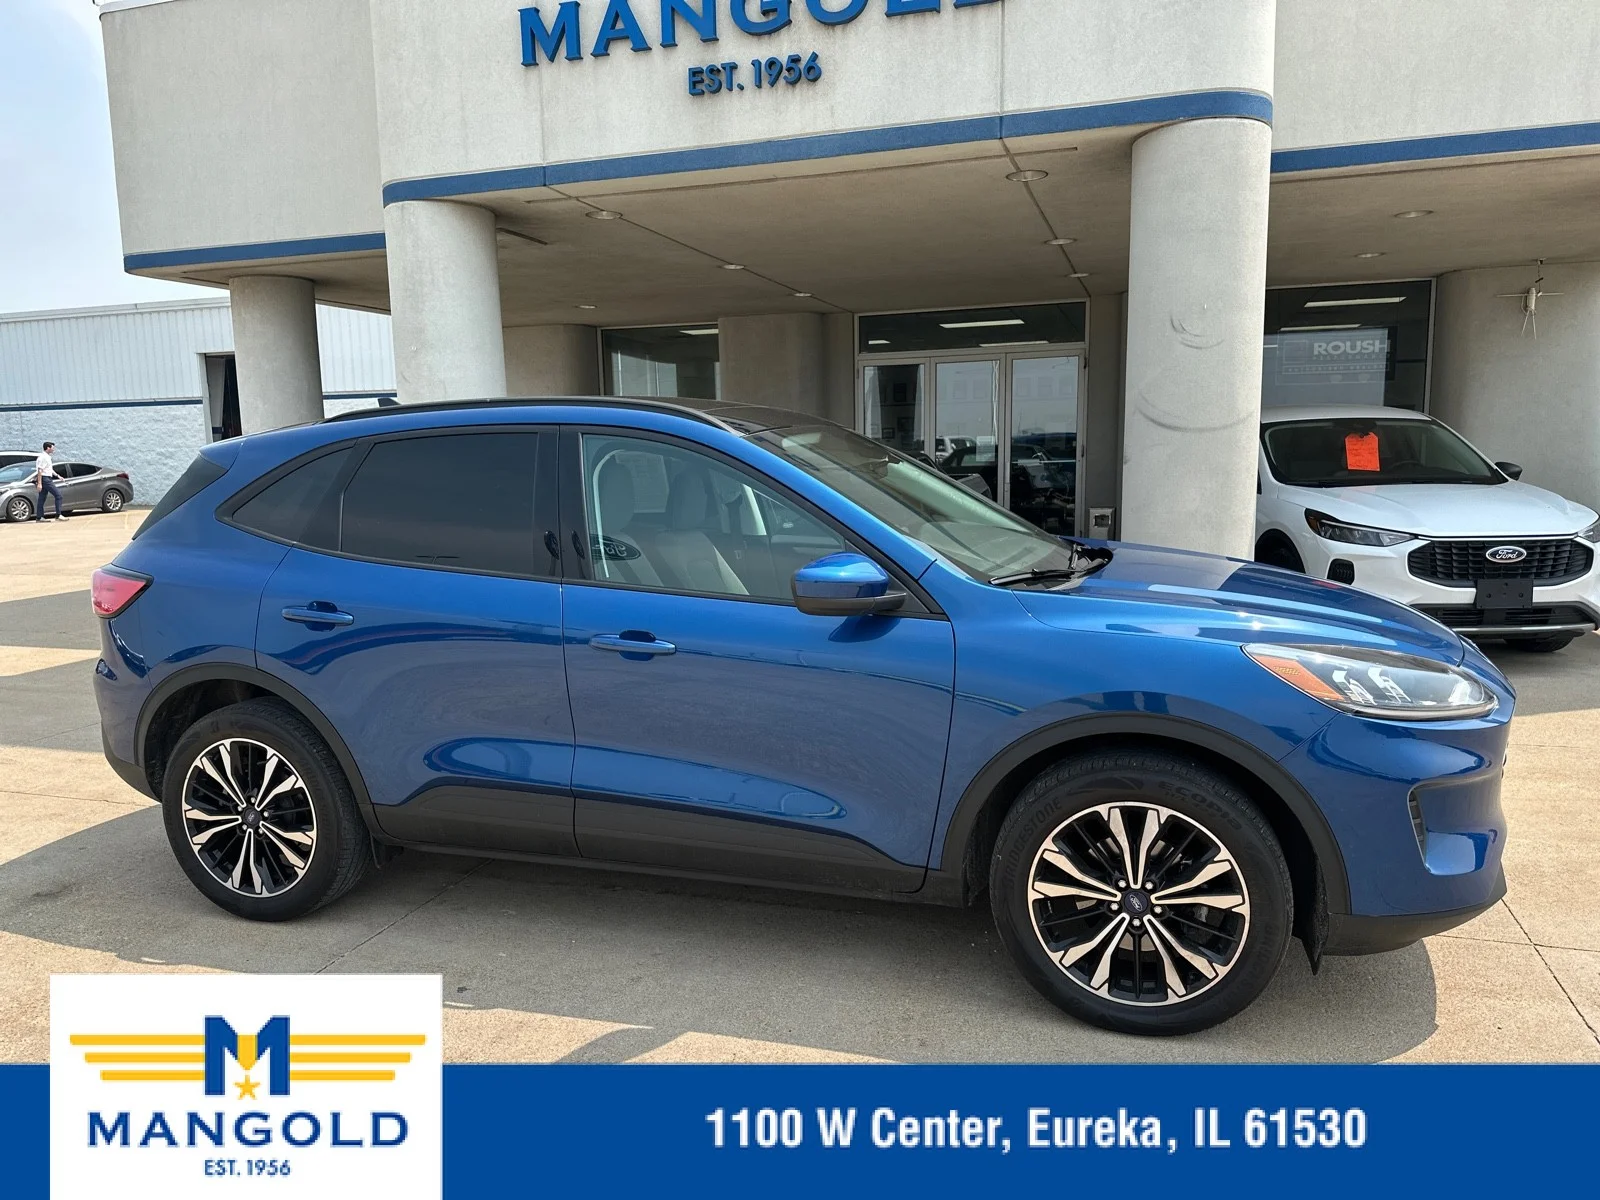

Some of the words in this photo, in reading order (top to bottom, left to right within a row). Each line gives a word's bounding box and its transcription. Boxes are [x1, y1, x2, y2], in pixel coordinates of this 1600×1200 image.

[519, 0, 1000, 68] MANG
[687, 61, 745, 97] EST.
[750, 51, 823, 88] 1956
[1313, 340, 1391, 355] ROUSH
